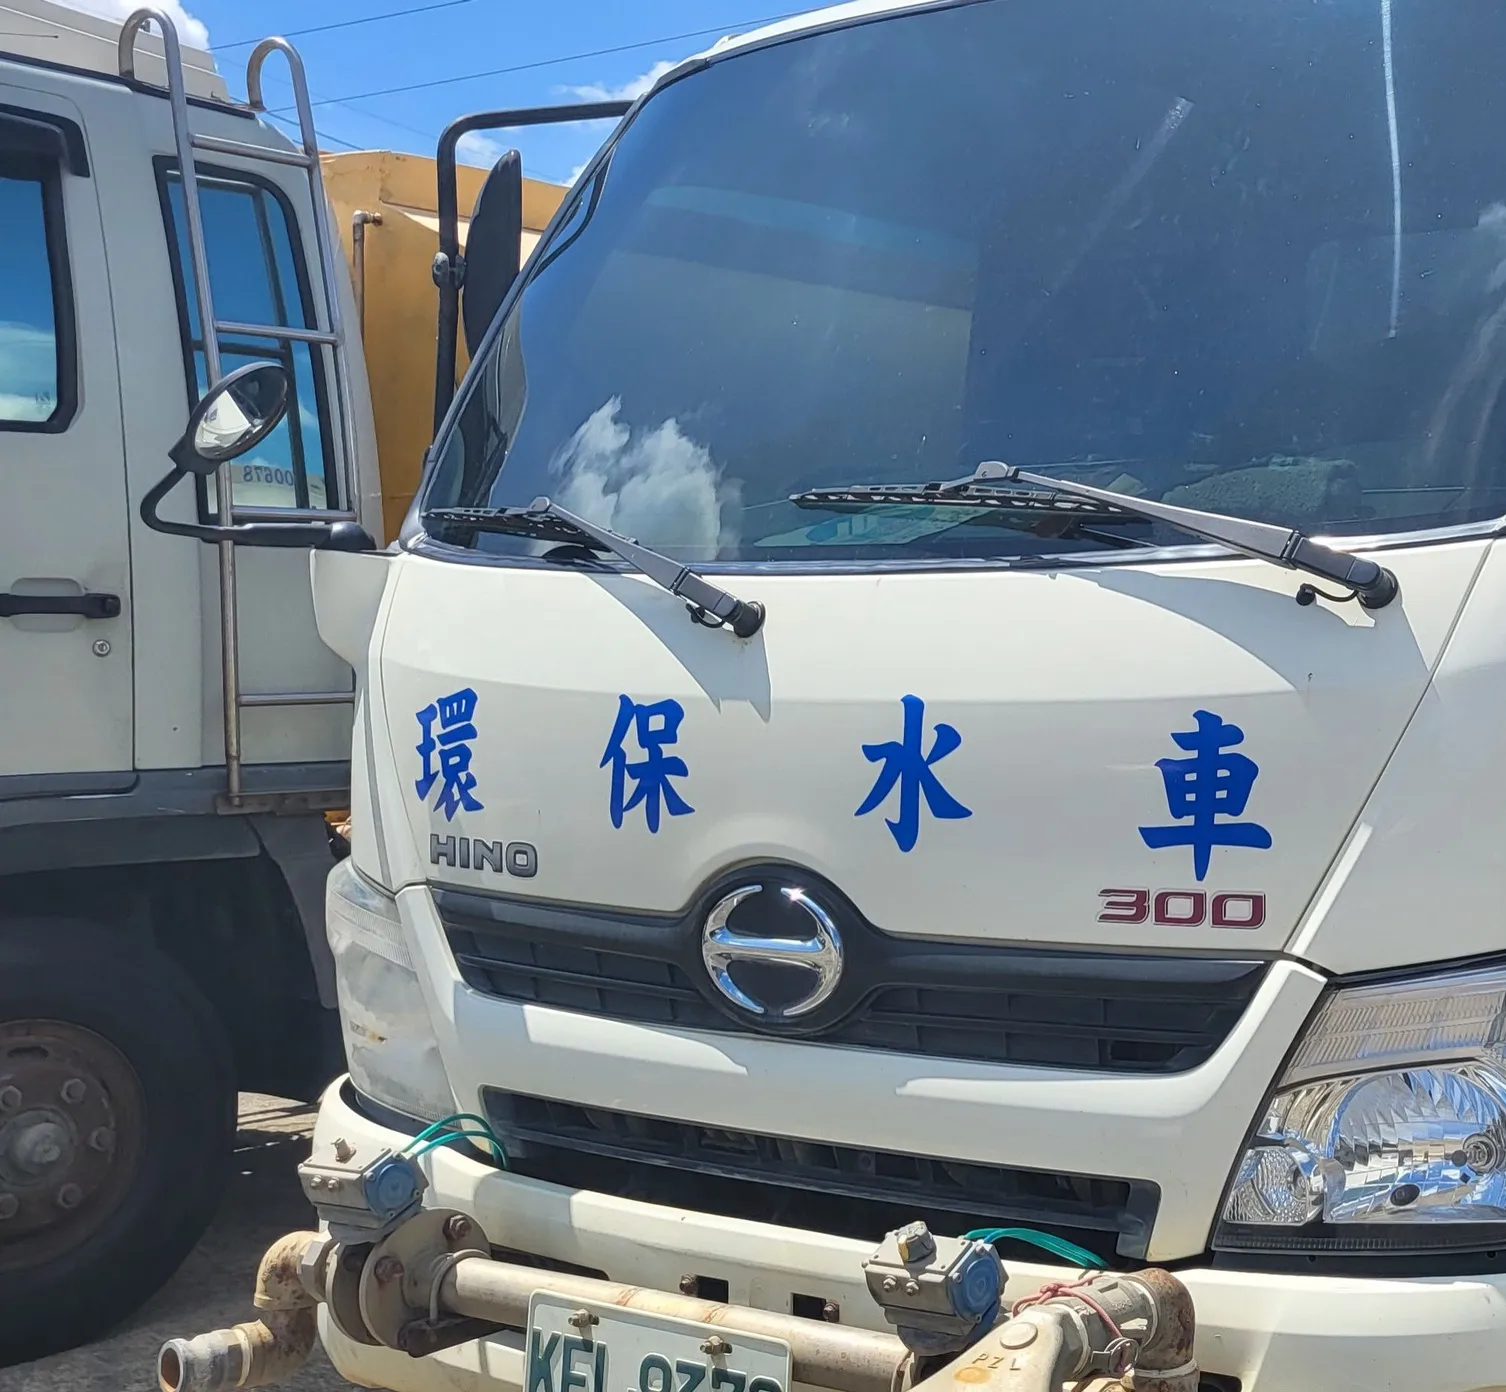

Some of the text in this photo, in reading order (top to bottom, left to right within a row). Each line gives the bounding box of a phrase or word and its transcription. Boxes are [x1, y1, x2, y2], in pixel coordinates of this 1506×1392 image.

[415, 687, 1272, 880] 環保水車
[430, 833, 538, 878] HINO
[1097, 888, 1266, 929] 300
